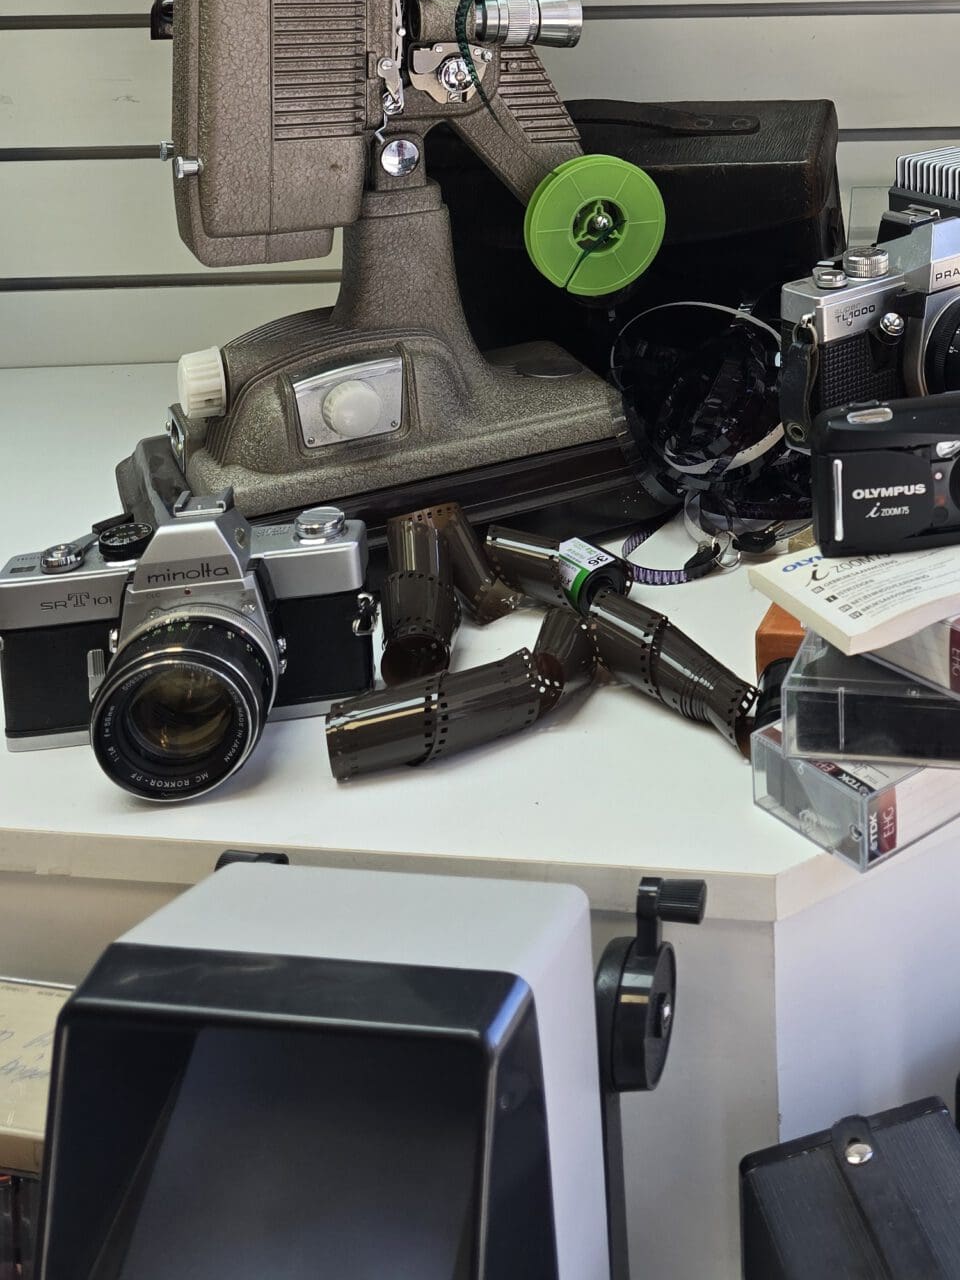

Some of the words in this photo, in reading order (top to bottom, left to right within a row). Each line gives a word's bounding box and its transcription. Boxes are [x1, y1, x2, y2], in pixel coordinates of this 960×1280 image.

[835, 304, 876, 324] TL1000
[851, 483, 927, 501] OLYMPUS
[880, 505, 910, 518] ZOOM75
[146, 562, 231, 585] minolta
[223, 738, 242, 763] JAPAN
[195, 771, 210, 784] MC
[869, 811, 879, 843] TDK
